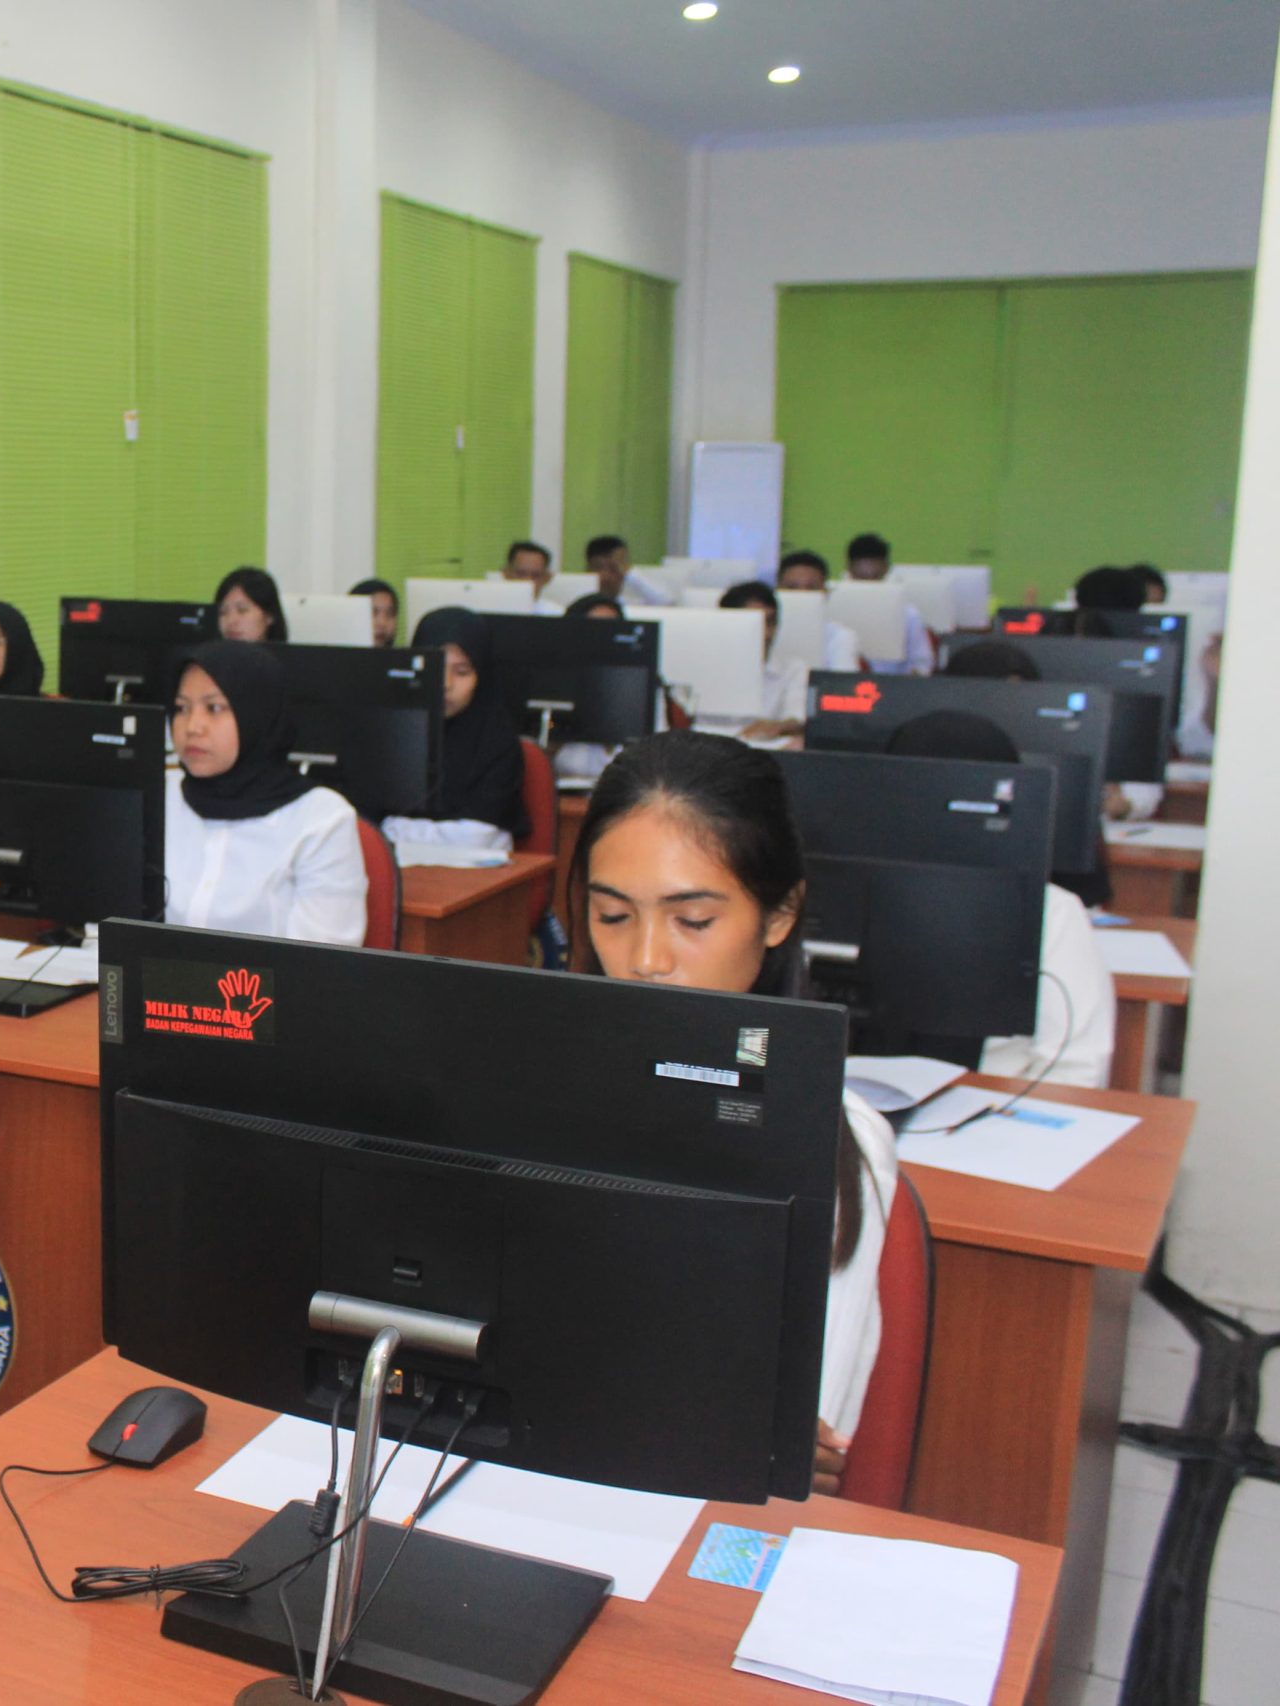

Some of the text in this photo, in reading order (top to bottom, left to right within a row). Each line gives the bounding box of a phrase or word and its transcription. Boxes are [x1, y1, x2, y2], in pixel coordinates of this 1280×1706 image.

[105, 970, 118, 1036] Lenovo
[144, 1000, 189, 1020] MILIK
[145, 1017, 255, 1041] BADAN KEPEGAWAIAN NEGARA
